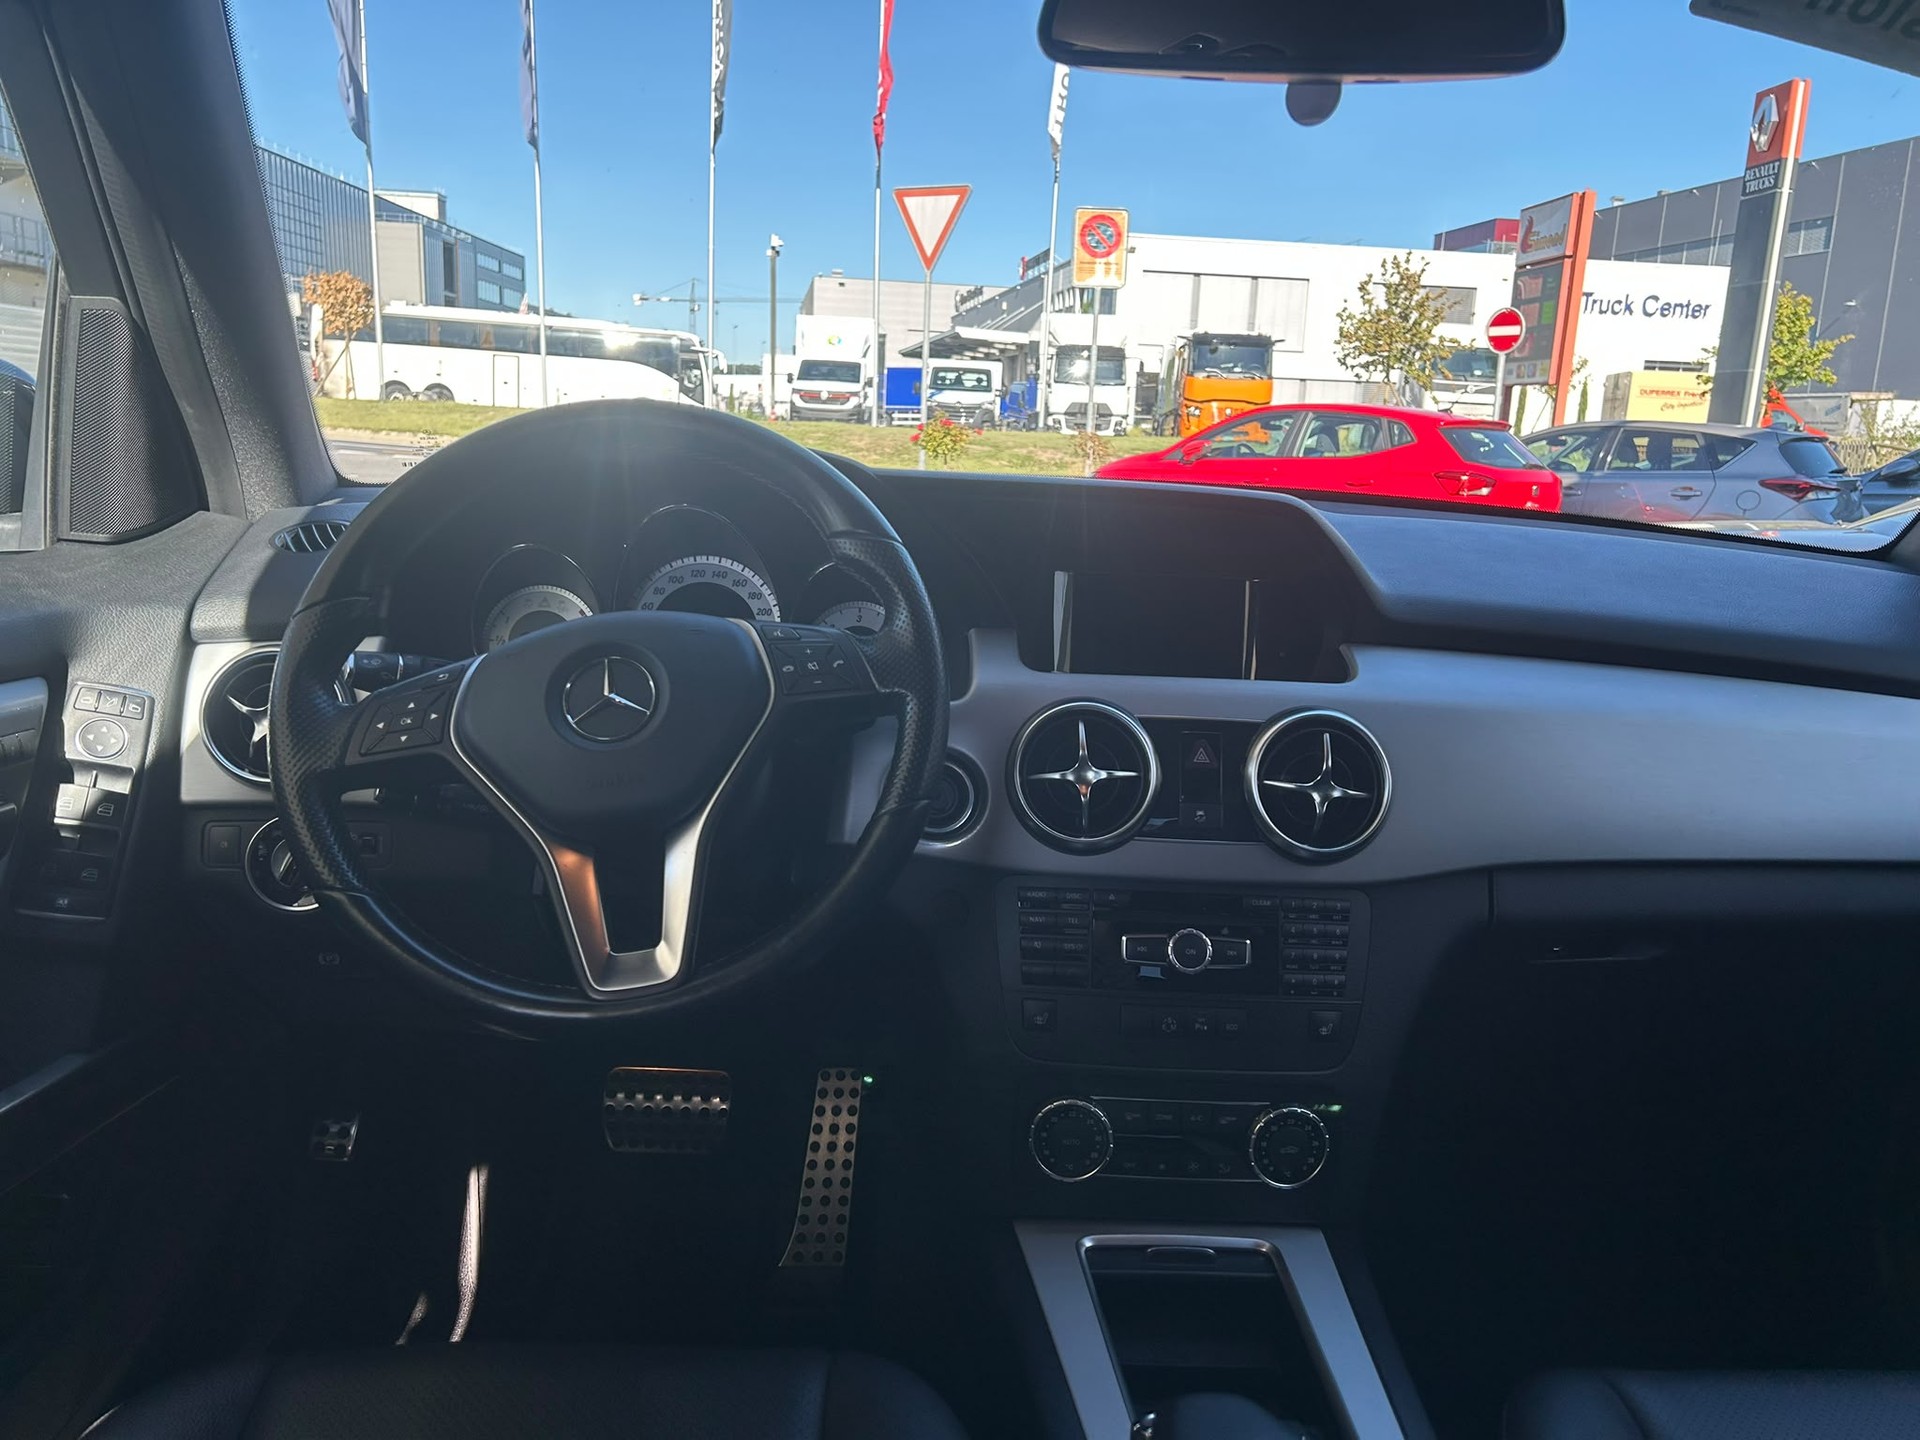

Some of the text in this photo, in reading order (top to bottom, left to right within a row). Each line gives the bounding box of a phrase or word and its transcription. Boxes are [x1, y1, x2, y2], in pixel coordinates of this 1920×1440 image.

[1744, 161, 1780, 181] RENAULT
[1745, 175, 1776, 193] TRUCKS
[1582, 291, 1711, 319] Truck Center
[690, 569, 706, 578] 120
[712, 570, 728, 580] 140
[668, 575, 684, 584] 100
[731, 578, 748, 588] 160
[652, 587, 666, 596] 80
[747, 591, 763, 601] 180
[641, 602, 654, 610] 60
[756, 607, 773, 617] 200
[856, 614, 863, 623] 3
